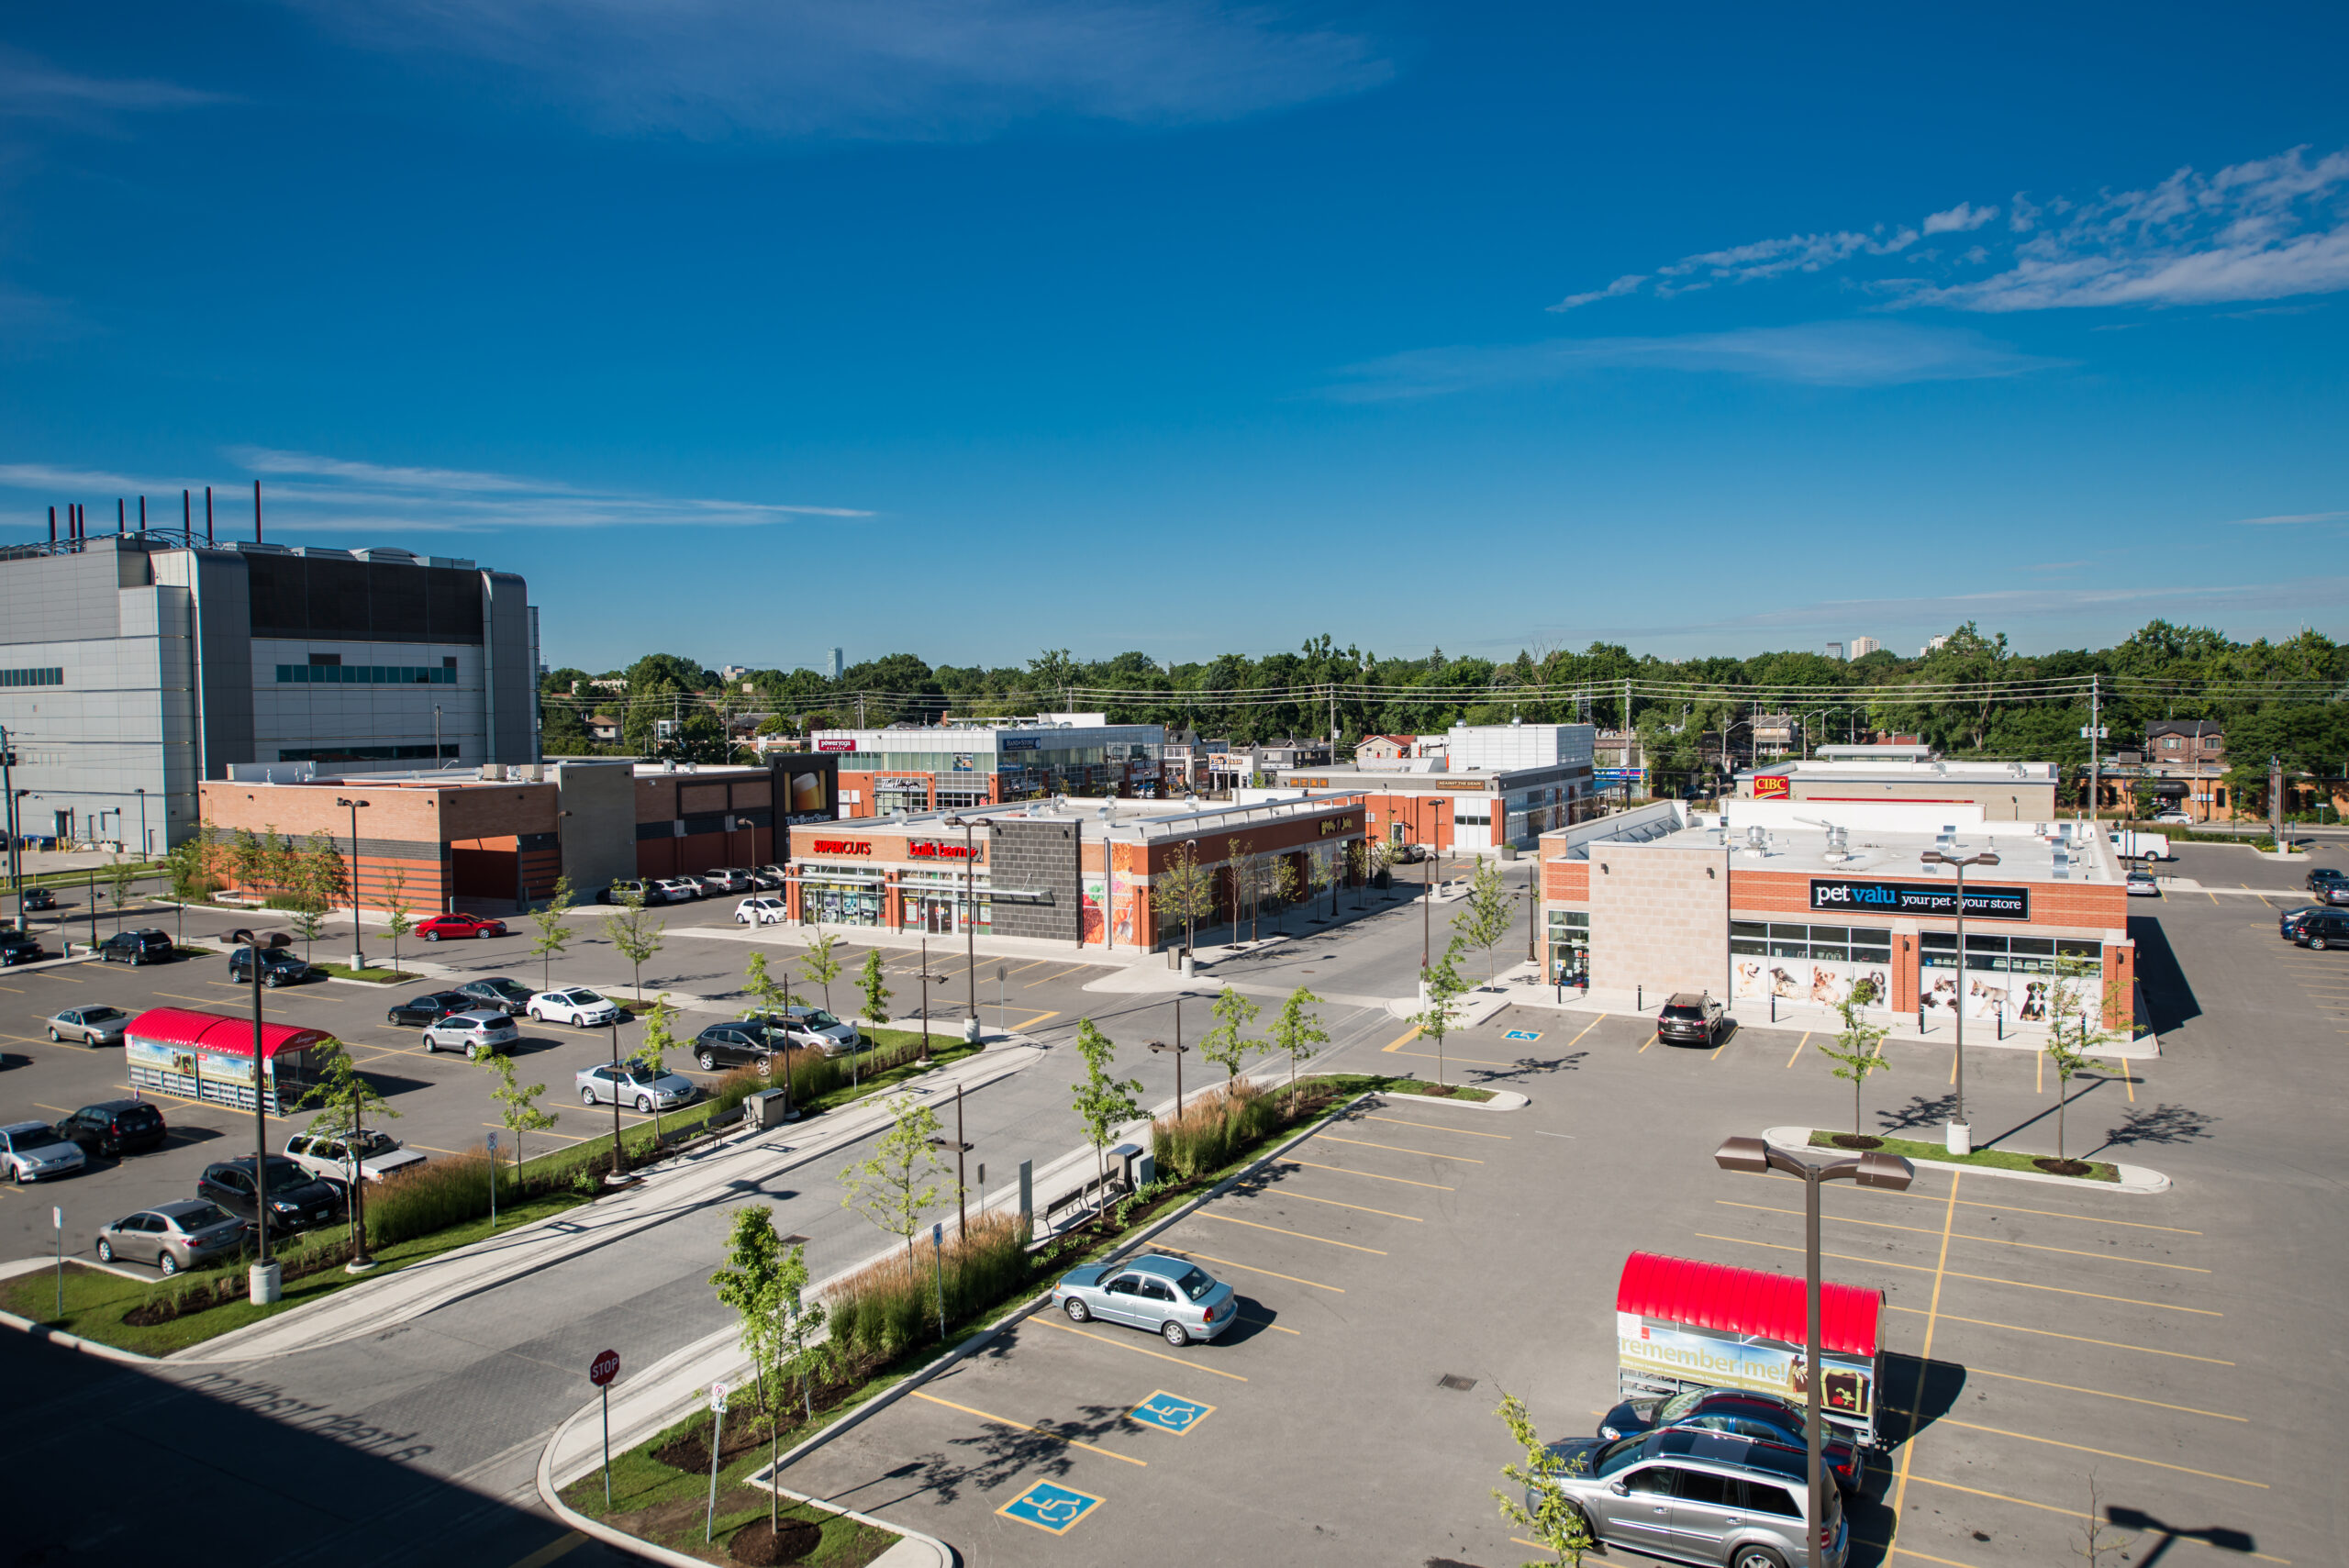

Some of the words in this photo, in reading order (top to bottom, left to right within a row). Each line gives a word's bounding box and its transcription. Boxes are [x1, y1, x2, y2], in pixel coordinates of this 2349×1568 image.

[1755, 778, 1787, 790] CIBC
[813, 840, 872, 855] SUPERCUTS
[909, 840, 936, 856] bulk
[938, 842, 967, 858] barn
[1816, 884, 1850, 906] pet
[1851, 885, 1897, 904] valu
[1901, 895, 1930, 906] your
[1932, 895, 1952, 907] pet
[1960, 898, 1989, 909] your
[1990, 898, 2022, 909] store
[593, 1357, 618, 1378] STOP
[1620, 1337, 1739, 1373] remember
[1744, 1360, 1787, 1382] me!
